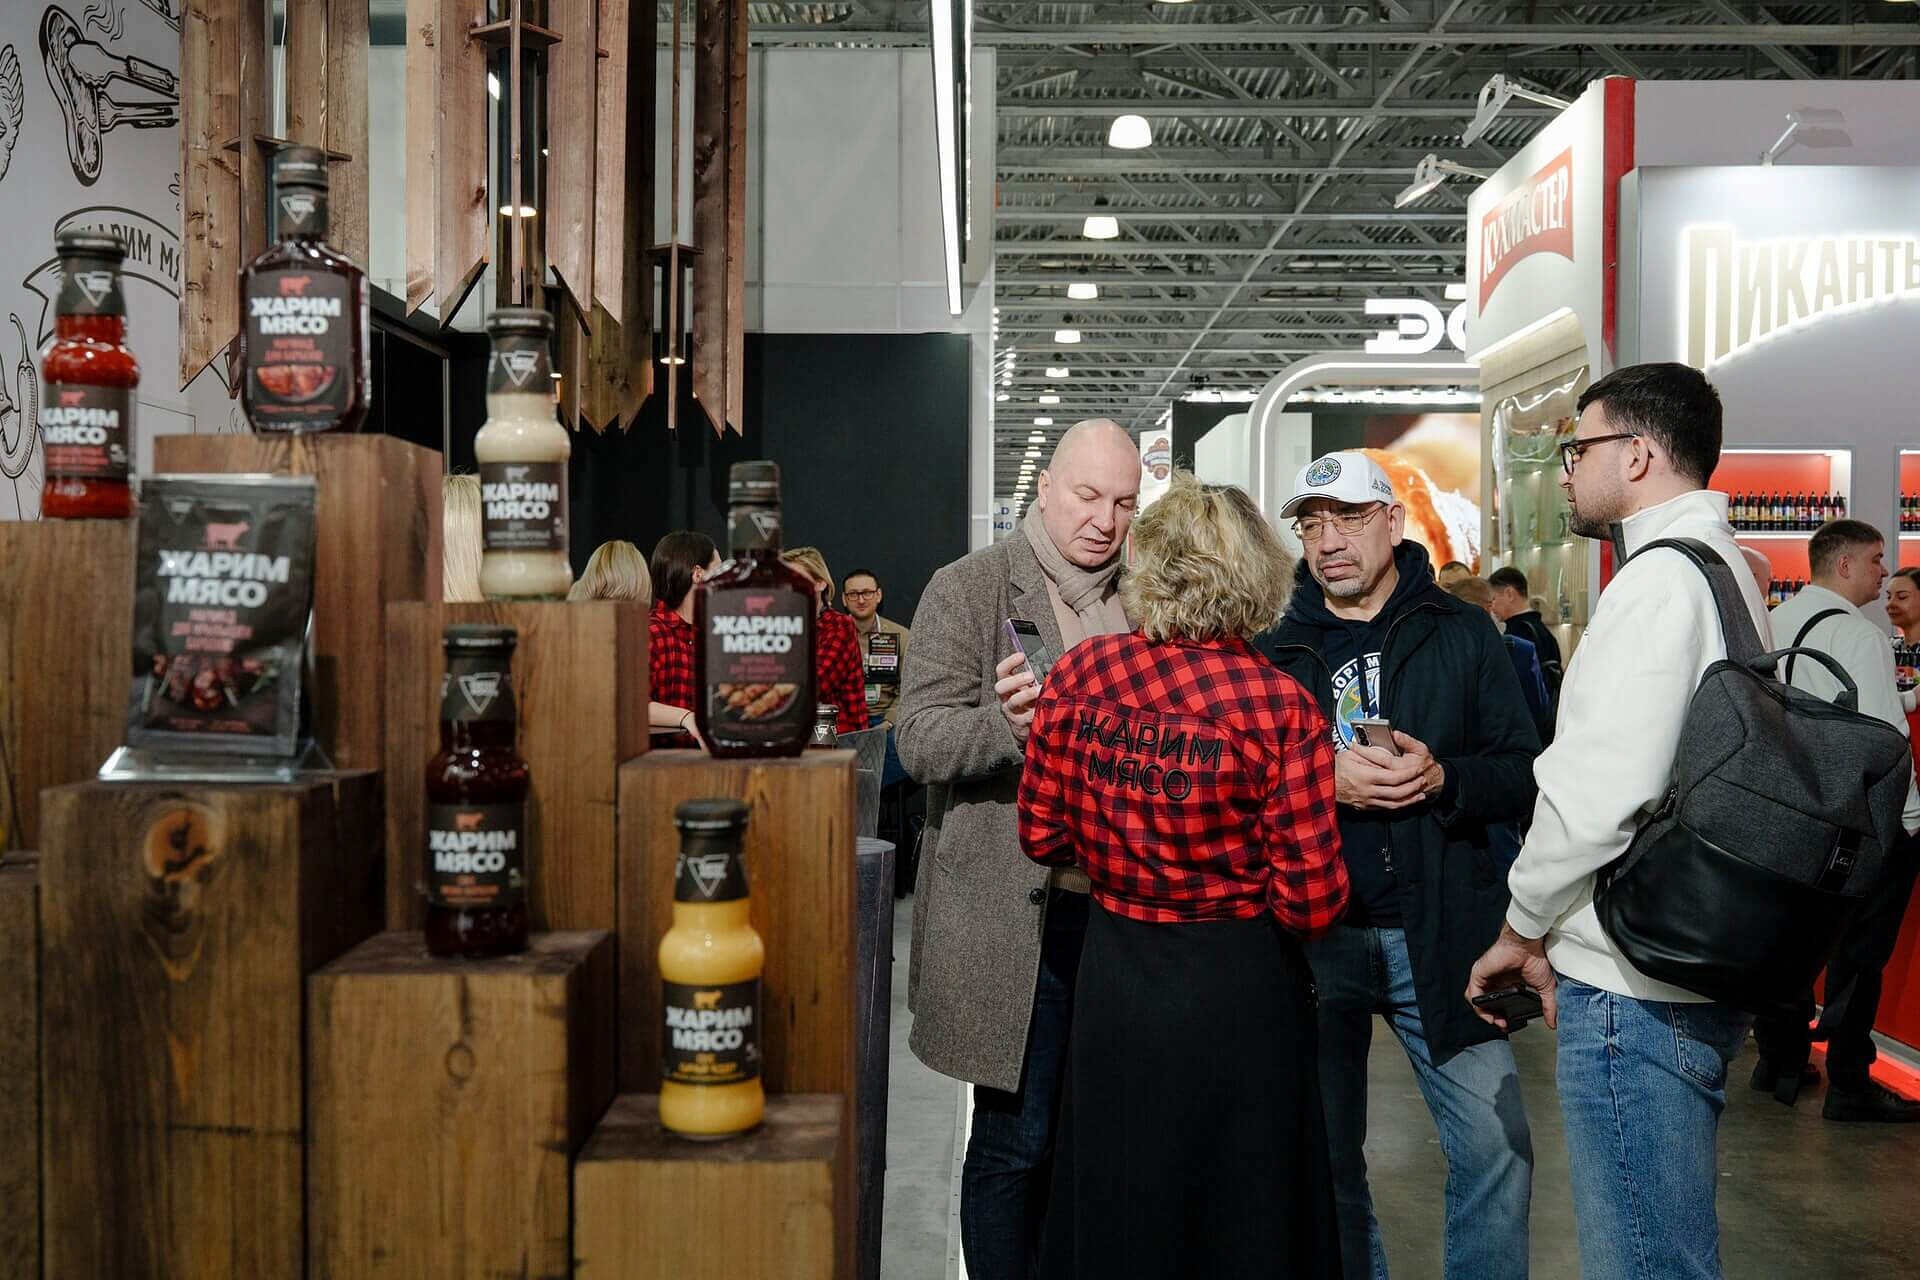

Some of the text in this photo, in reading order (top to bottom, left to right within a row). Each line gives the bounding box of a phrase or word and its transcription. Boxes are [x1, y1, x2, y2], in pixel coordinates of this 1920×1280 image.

[1483, 165, 1569, 283] КУХМАСТЕР
[250, 297, 341, 317] ЖАРИМ
[260, 315, 329, 335] МЯСО
[45, 425, 107, 445] МЯСО
[487, 500, 550, 520] МЯСО
[157, 549, 291, 583] ЖАРИМ
[167, 577, 268, 608] МЯСО
[712, 616, 804, 635] ЖАРИМ
[723, 634, 793, 653] МЯСО
[1075, 709, 1223, 770] ЖАРИМ
[1088, 751, 1192, 801] МЯСО
[429, 829, 517, 852] ЖАРИМ
[435, 851, 506, 873] МЯСО
[666, 1005, 752, 1030] ЖАРИМ
[673, 1028, 743, 1051] МЯСО
